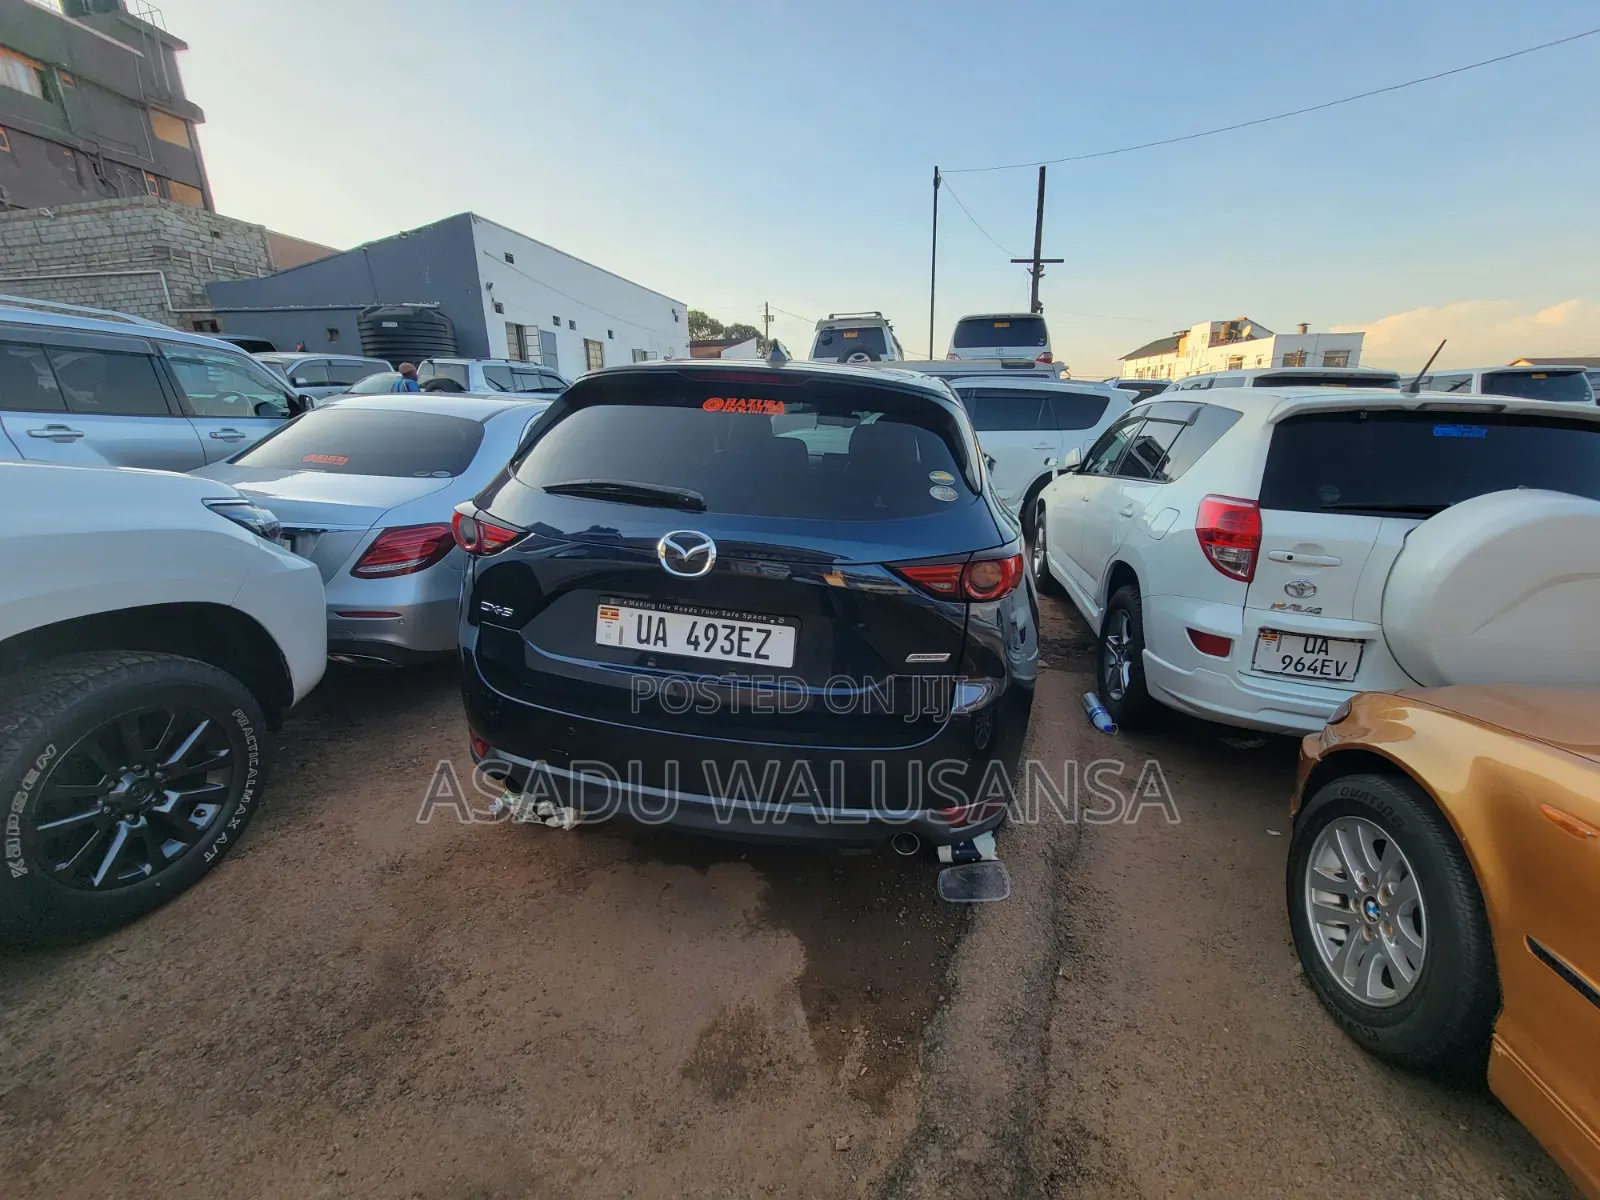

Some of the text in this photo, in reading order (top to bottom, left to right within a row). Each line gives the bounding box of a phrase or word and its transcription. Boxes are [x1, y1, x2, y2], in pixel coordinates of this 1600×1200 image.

[628, 599, 768, 621] Making the Roads Your Safe Space
[636, 613, 772, 660] UA 493EZ
[1303, 636, 1329, 656] UA
[1281, 654, 1348, 677] 964EV
